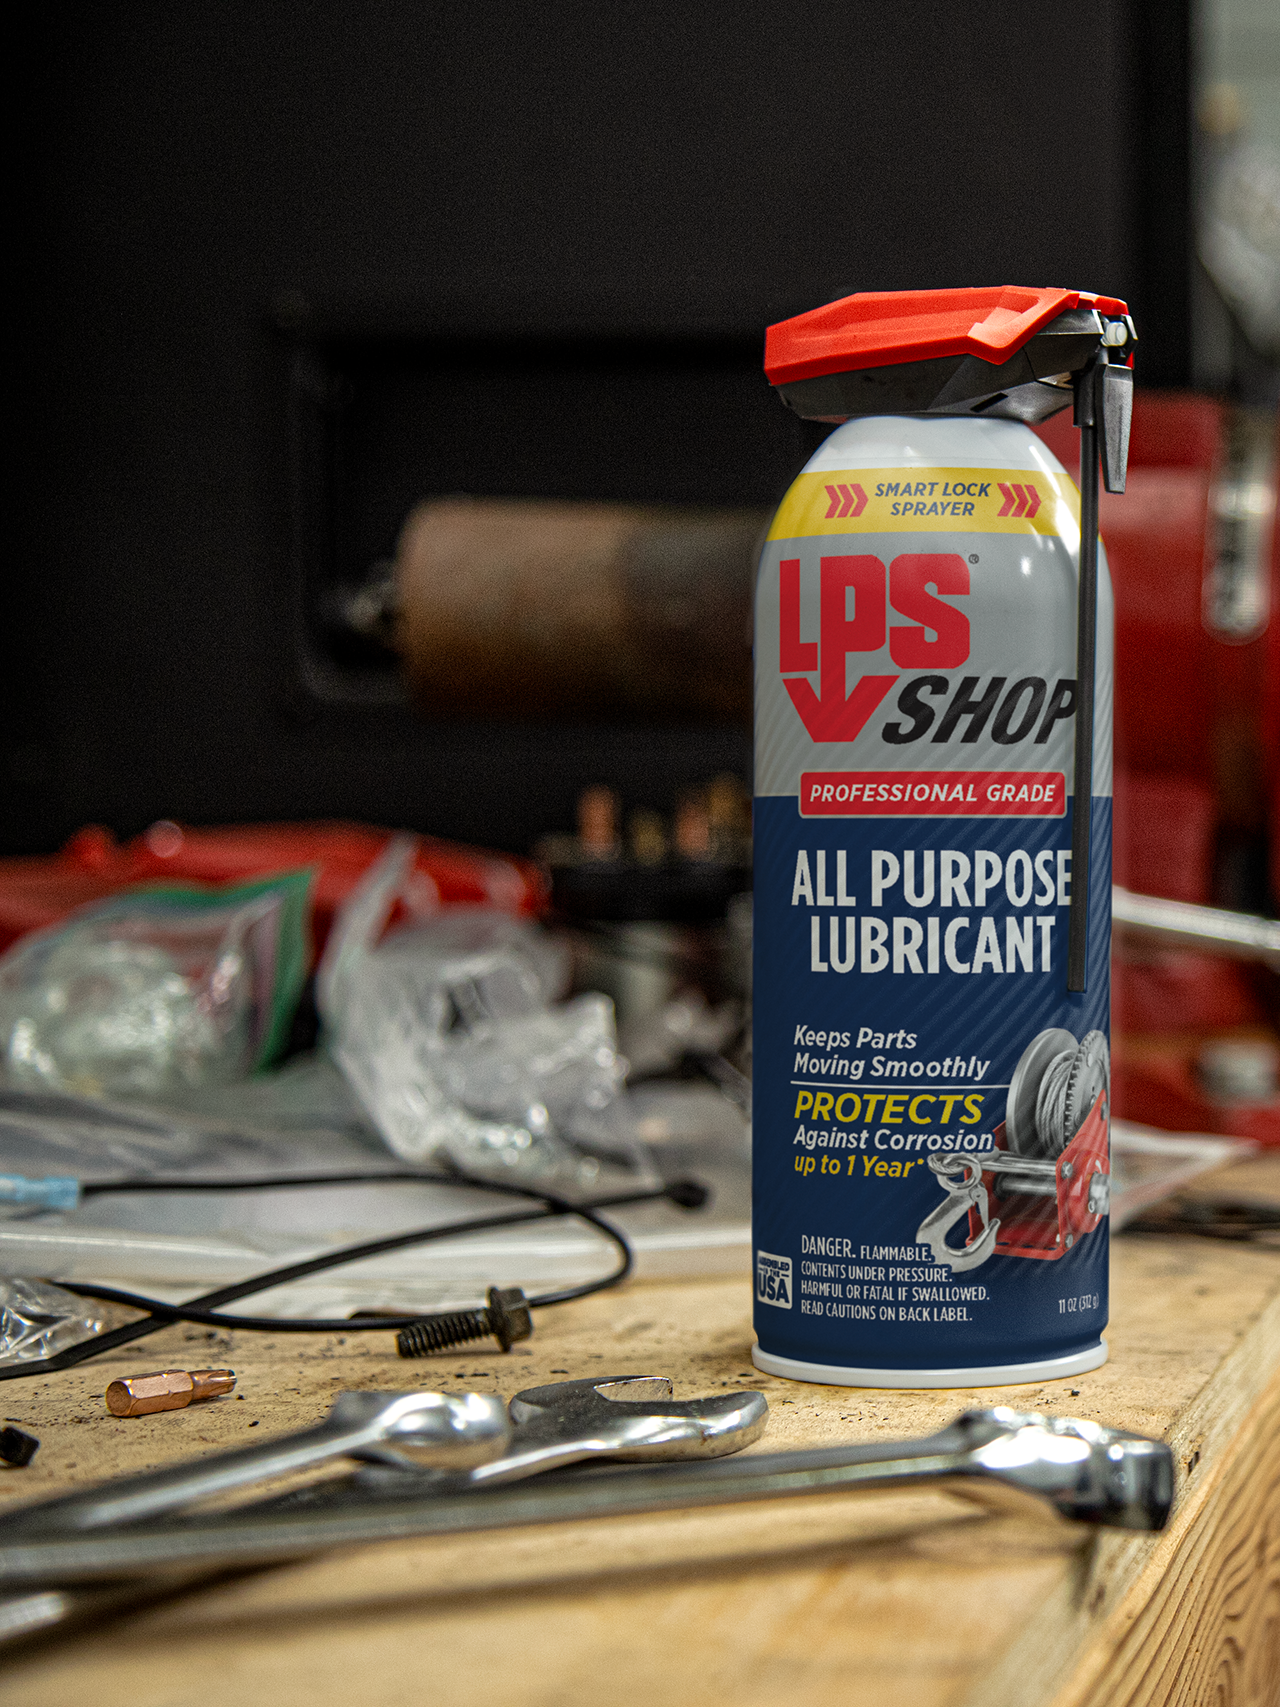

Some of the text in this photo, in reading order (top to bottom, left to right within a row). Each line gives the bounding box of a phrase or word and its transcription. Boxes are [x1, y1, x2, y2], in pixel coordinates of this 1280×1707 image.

[875, 482, 991, 497] SMART LOCK
[890, 502, 975, 516] SPRAYER
[881, 675, 1078, 745] SHOP
[810, 784, 1056, 802] PROFESSIONAL GRADE
[791, 849, 1072, 908] ALL PURPOSE
[810, 915, 1056, 974] LUBRICANT
[794, 1024, 917, 1051] Keeps Parts
[794, 1052, 990, 1081] Moving Smoothly
[794, 1090, 985, 1124] PROTECTS
[793, 1124, 993, 1151] Against Corrosion
[794, 1155, 816, 1176] up
[821, 1155, 841, 1174] to
[846, 1155, 855, 1176] 1
[801, 1235, 932, 1262] DANGER. FLAMMABLE.
[801, 1260, 953, 1282] CONTENTS UNDER PRESSURE.
[758, 1270, 790, 1304] USA
[801, 1280, 990, 1301] HARMFUL OR FATAL IF SWALLOWED.
[801, 1299, 973, 1322] READ CAUTIONS ON BACK LABEL.
[1058, 1298, 1066, 1314] 11
[1067, 1297, 1077, 1312] OZ
